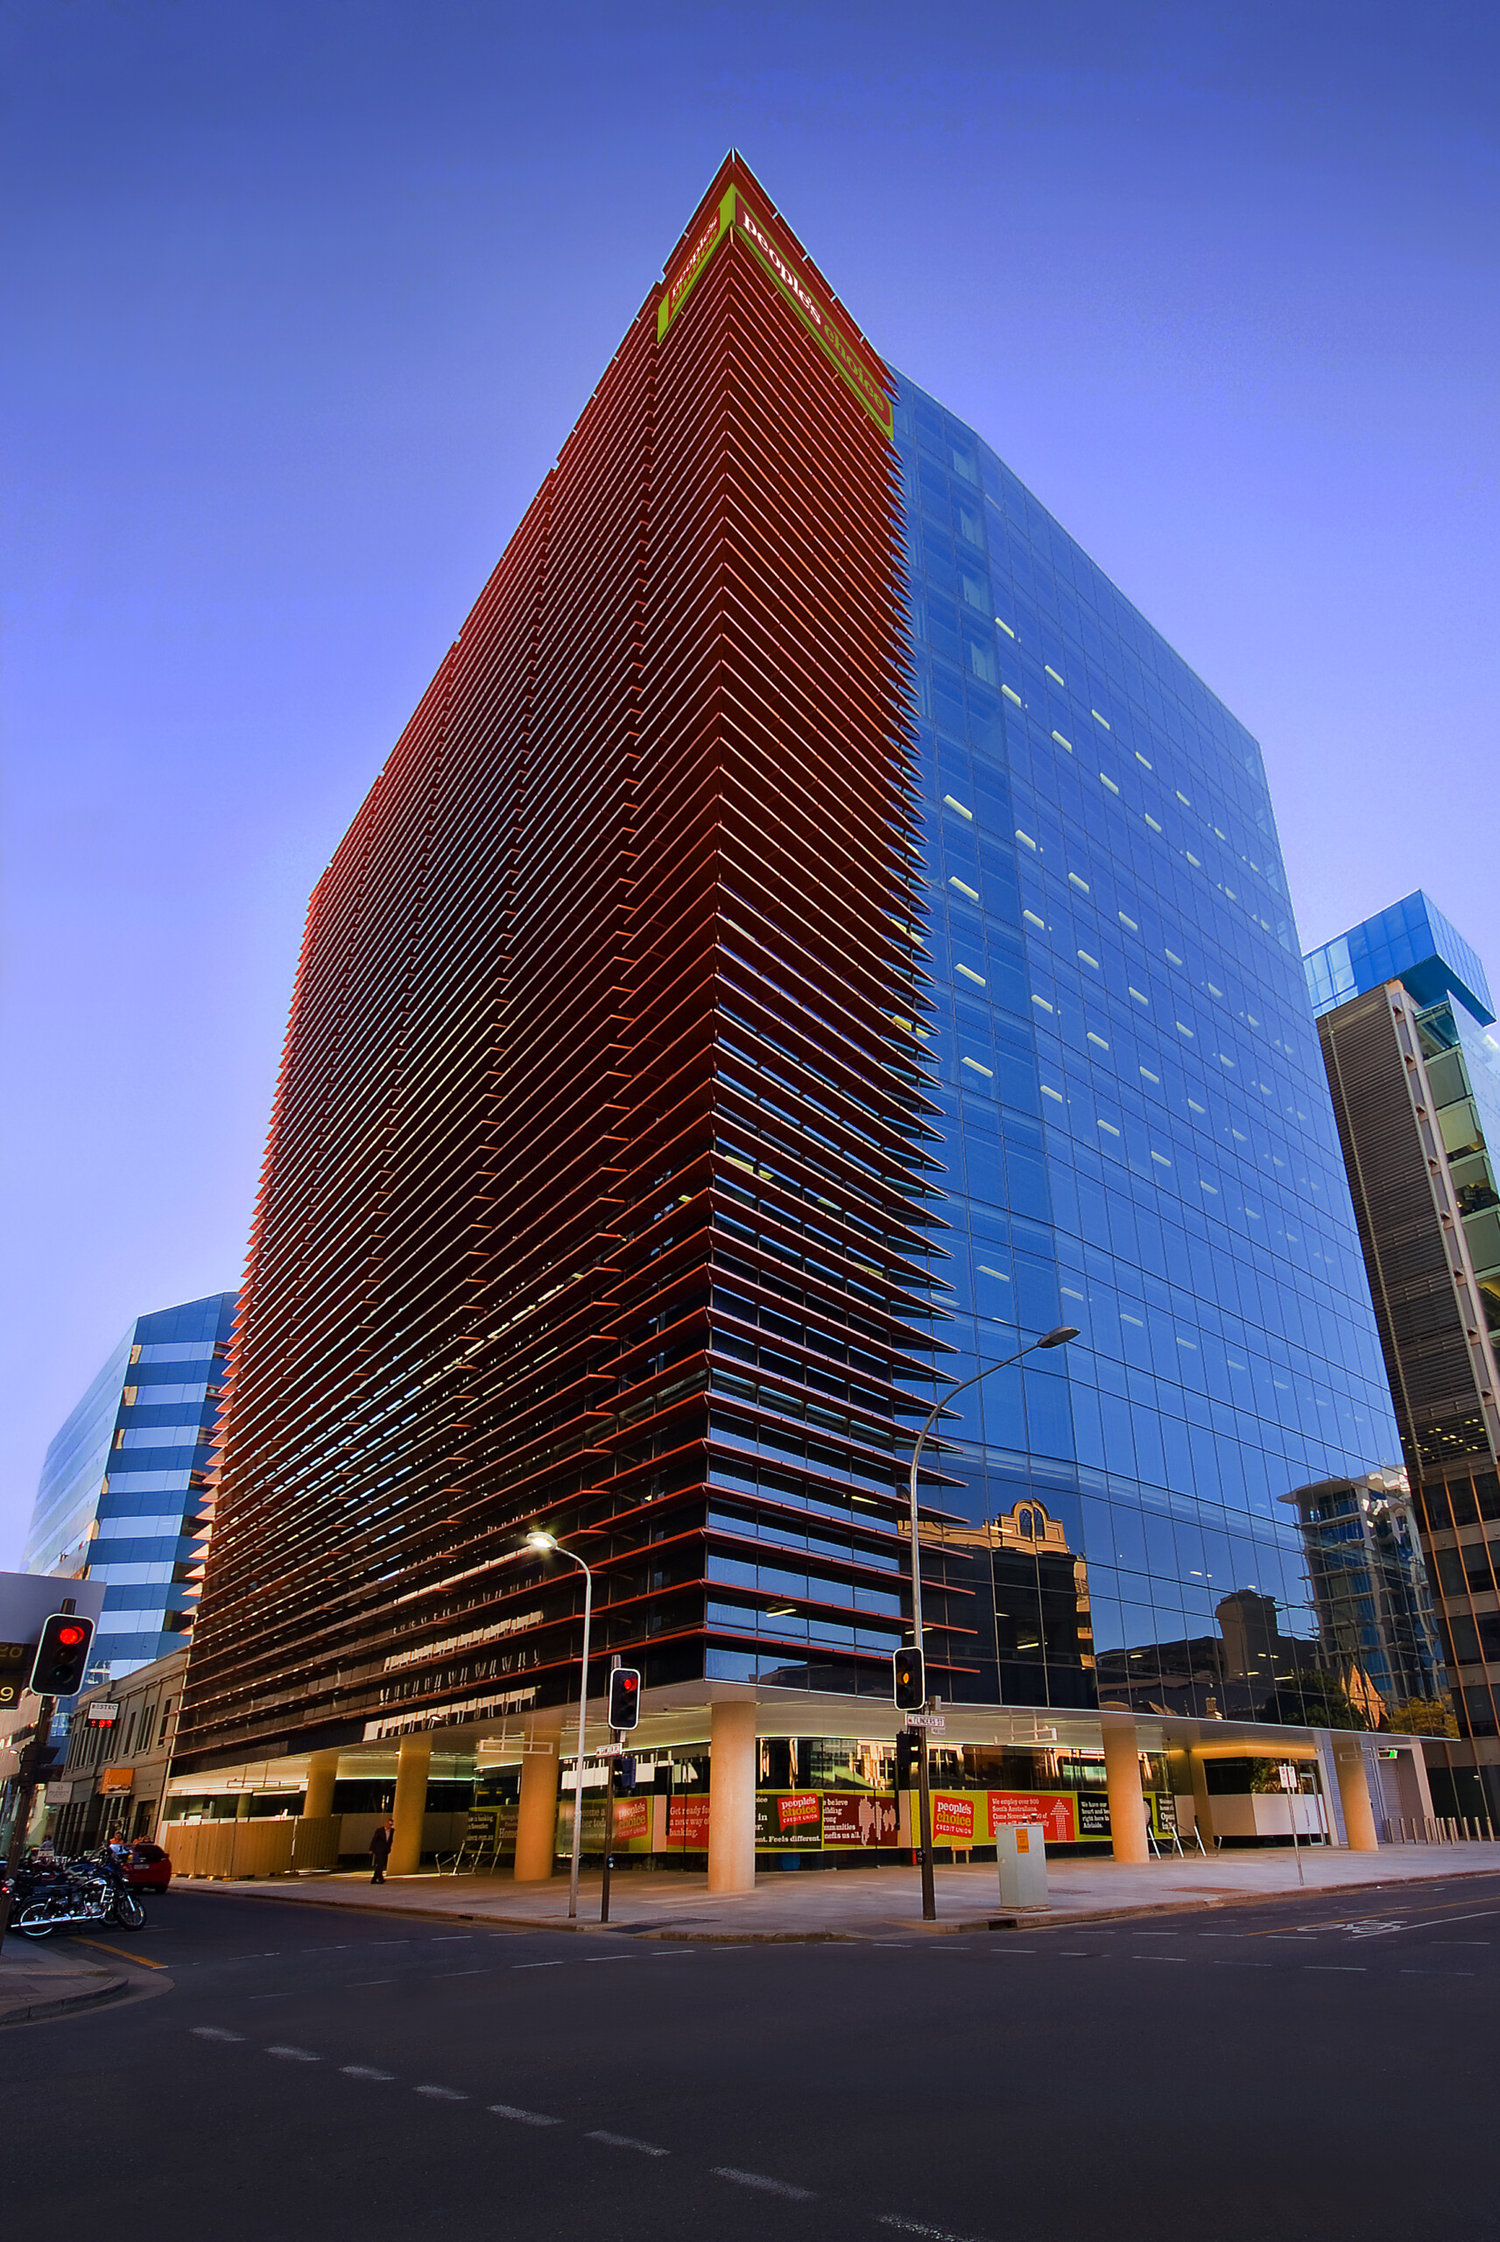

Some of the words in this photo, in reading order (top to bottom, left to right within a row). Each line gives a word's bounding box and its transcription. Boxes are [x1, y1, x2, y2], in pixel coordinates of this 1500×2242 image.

[742, 211, 821, 325] people's
[824, 324, 884, 411] choice
[781, 1796, 816, 1810] people's
[937, 1801, 972, 1815] people's
[669, 1806, 681, 1816] Get
[782, 1806, 817, 1818] choice
[936, 1810, 972, 1827] choice
[936, 1824, 955, 1832] CREDIT
